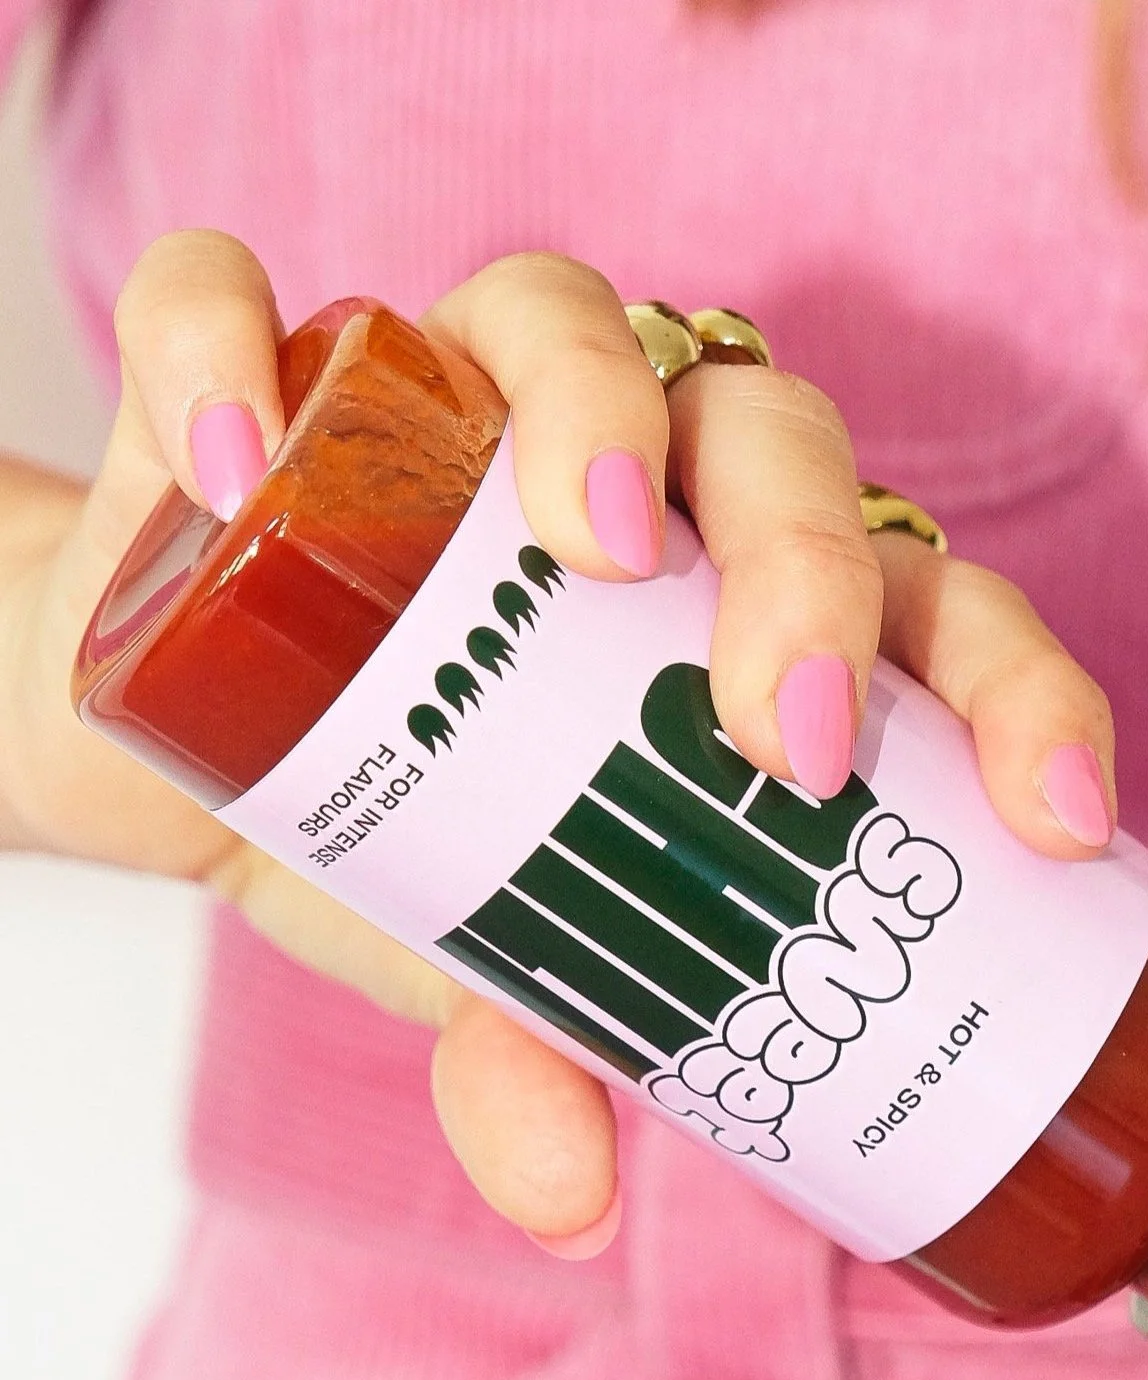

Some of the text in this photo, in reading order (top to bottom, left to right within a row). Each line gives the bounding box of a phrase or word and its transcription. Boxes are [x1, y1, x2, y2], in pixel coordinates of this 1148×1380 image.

[297, 743, 397, 837] FLAVOURS
[308, 762, 425, 868] FOR INTENSE
[433, 662, 879, 1081] CHILI
[852, 1000, 990, 1158] HOT & SPICY
